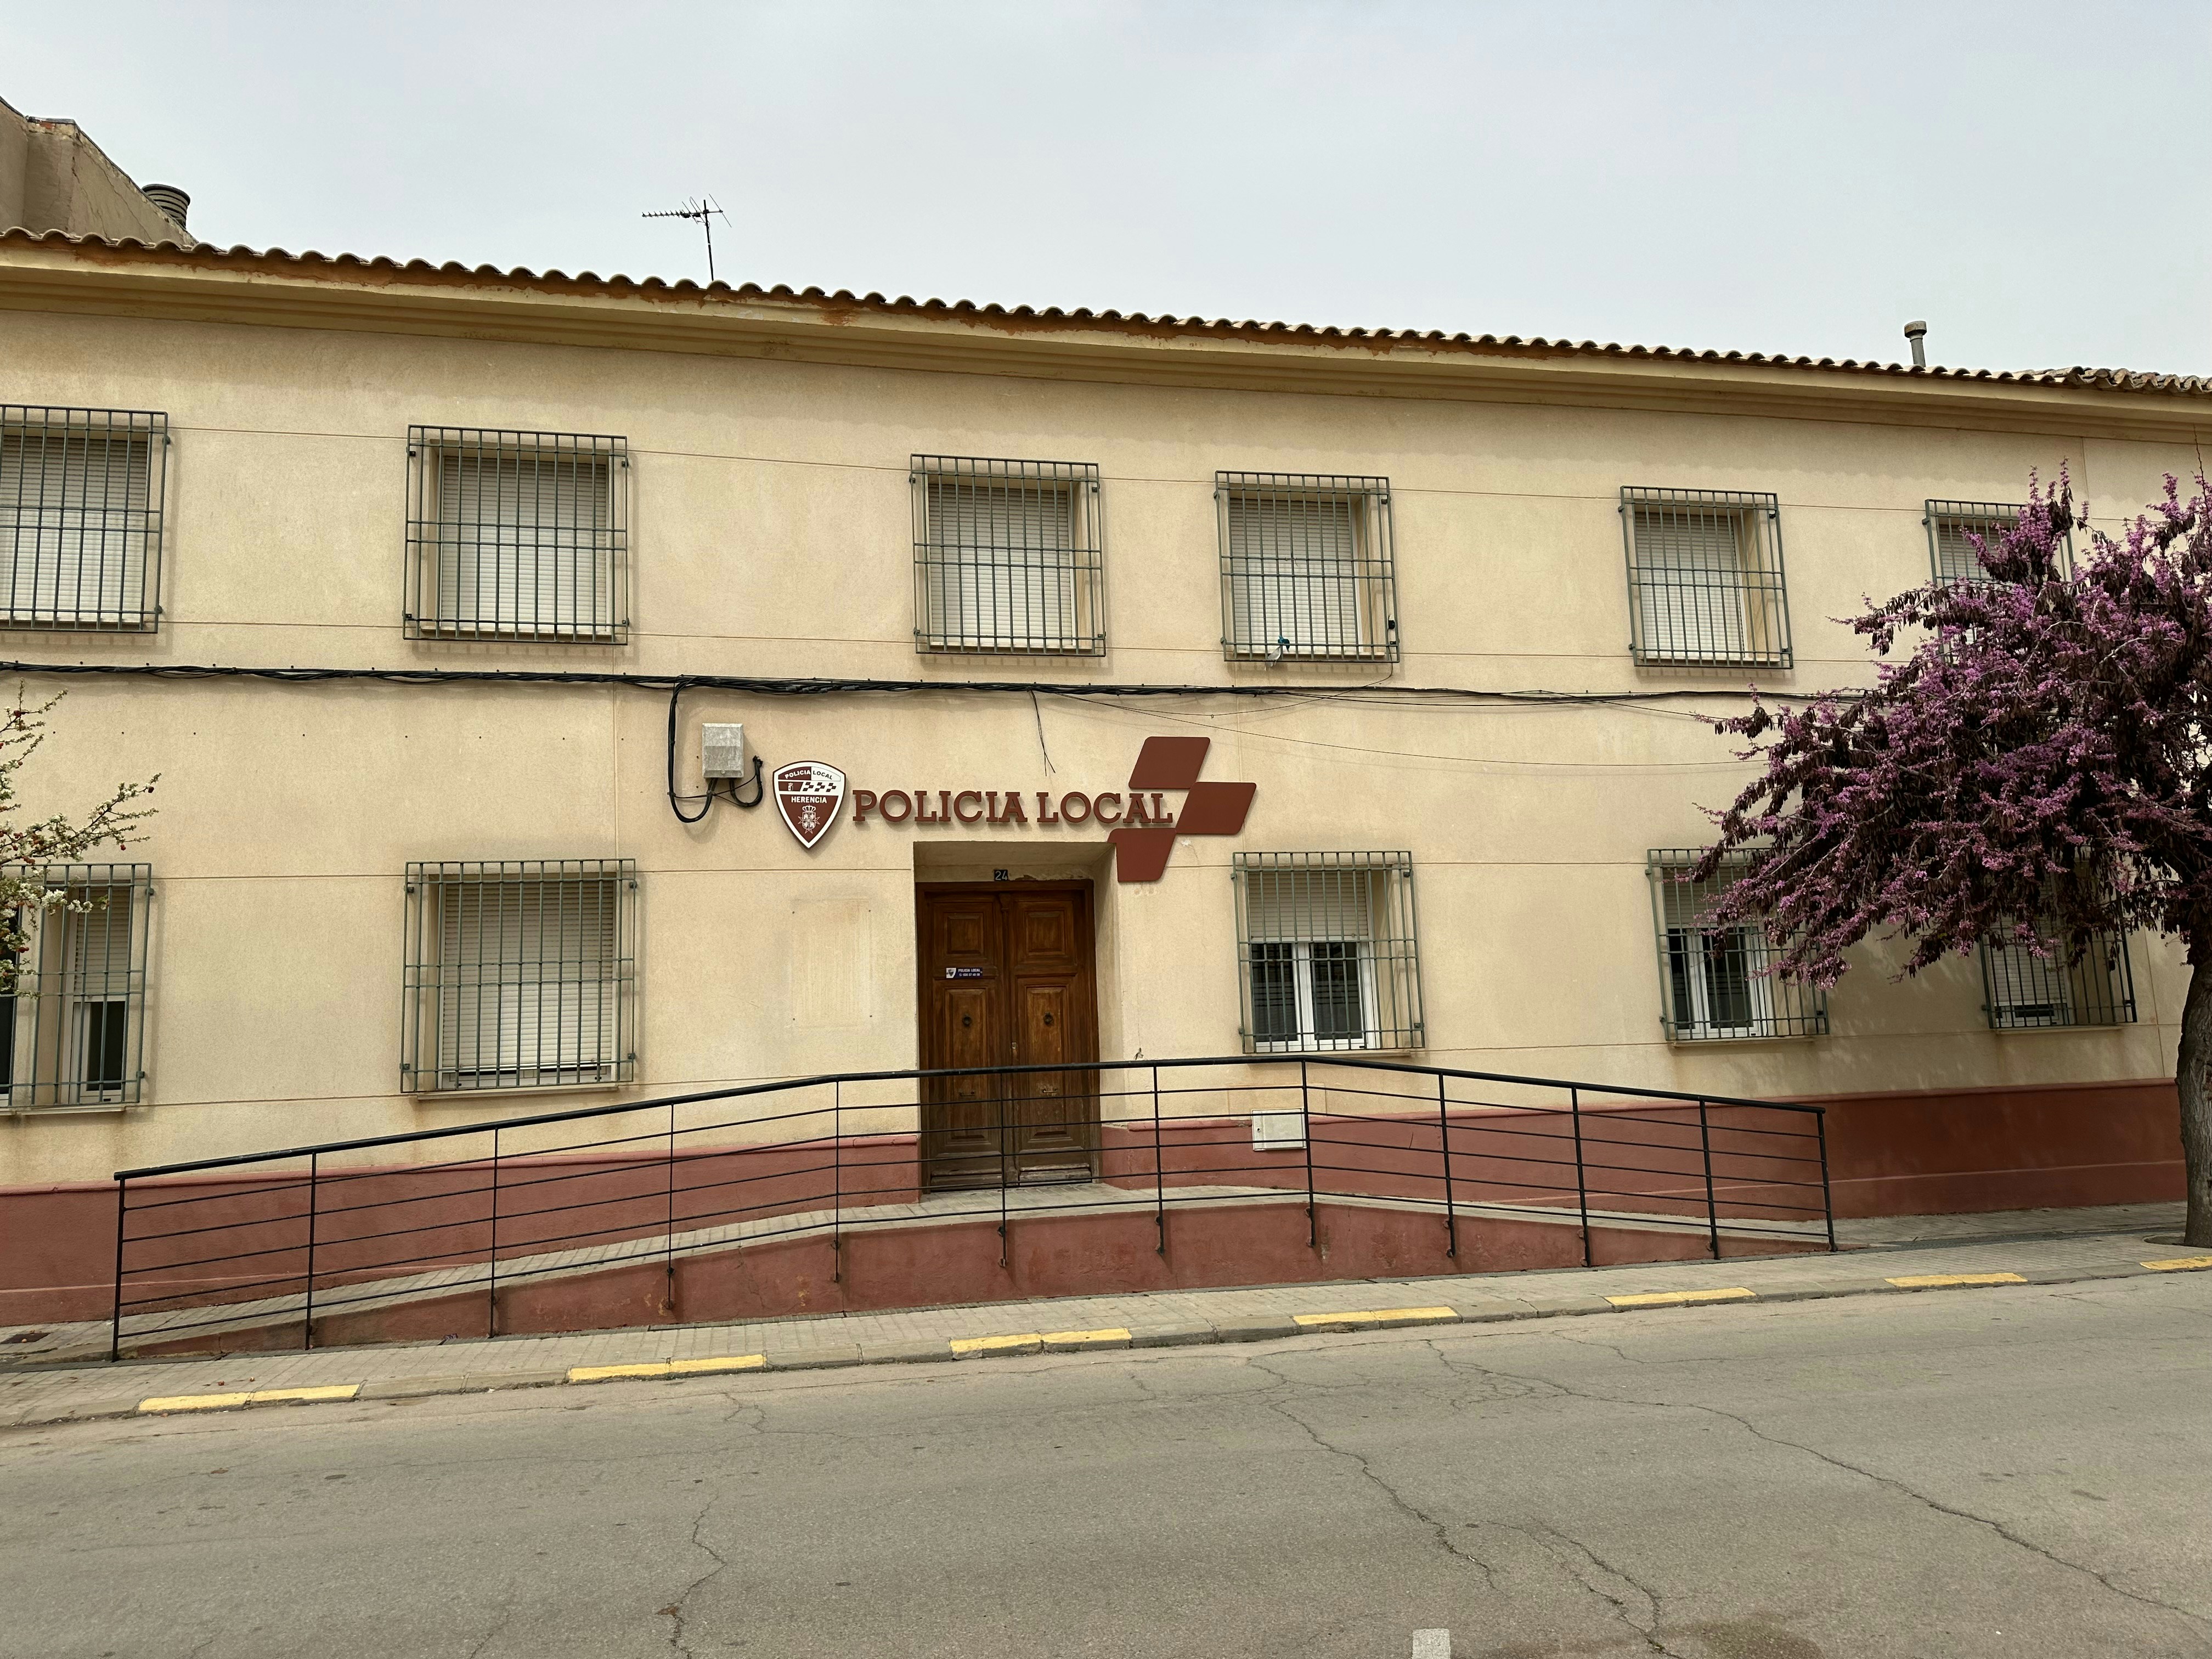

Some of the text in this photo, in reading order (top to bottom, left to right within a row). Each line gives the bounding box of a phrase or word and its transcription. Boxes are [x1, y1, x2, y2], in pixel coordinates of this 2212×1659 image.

[785, 770, 833, 780] POLICIA LOCAL
[853, 790, 1173, 823] POLICIA LOCAL
[995, 870, 1008, 880] 24
